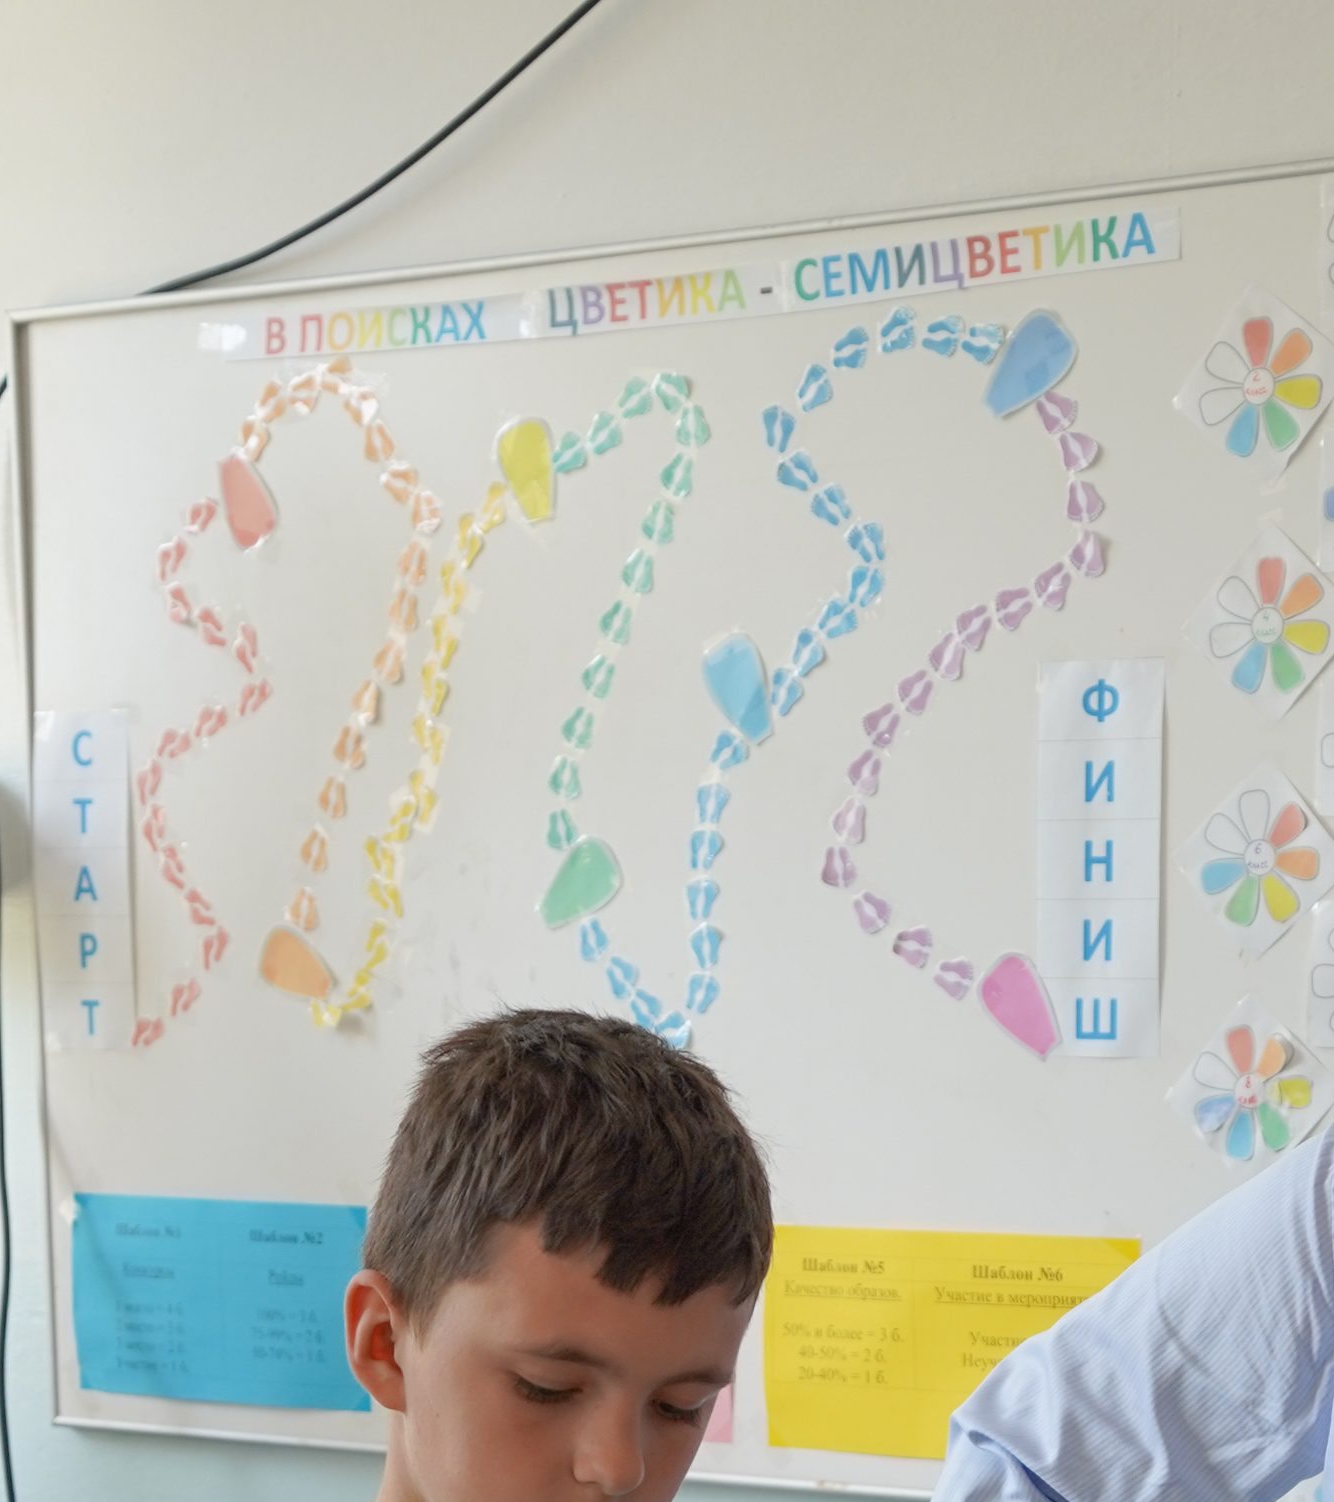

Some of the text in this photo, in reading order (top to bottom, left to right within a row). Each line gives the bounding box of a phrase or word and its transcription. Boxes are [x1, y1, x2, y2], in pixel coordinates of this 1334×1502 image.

[266, 316, 287, 355] В
[299, 300, 488, 353] ПОИСКАХ
[549, 268, 748, 335] ЦВЕТИКА
[794, 211, 1156, 301] СЕМИЦВЕТИКА
[1076, 679, 1120, 1041] ФИНИШ
[72, 730, 100, 1036] СТАРТ
[250, 1229, 323, 1246] Шаблон №2
[802, 1257, 885, 1275] Шаблон №5
[973, 1264, 1063, 1281] Шаблон №6
[784, 1279, 844, 1296] Качество
[935, 1286, 1087, 1309] Участие в мероприят
[783, 1322, 811, 1338] 50%
[827, 1324, 864, 1340] более
[799, 1345, 847, 1361] 40-50%
[962, 1353, 1002, 1371] Неуч
[799, 1366, 847, 1383] 20-40%
